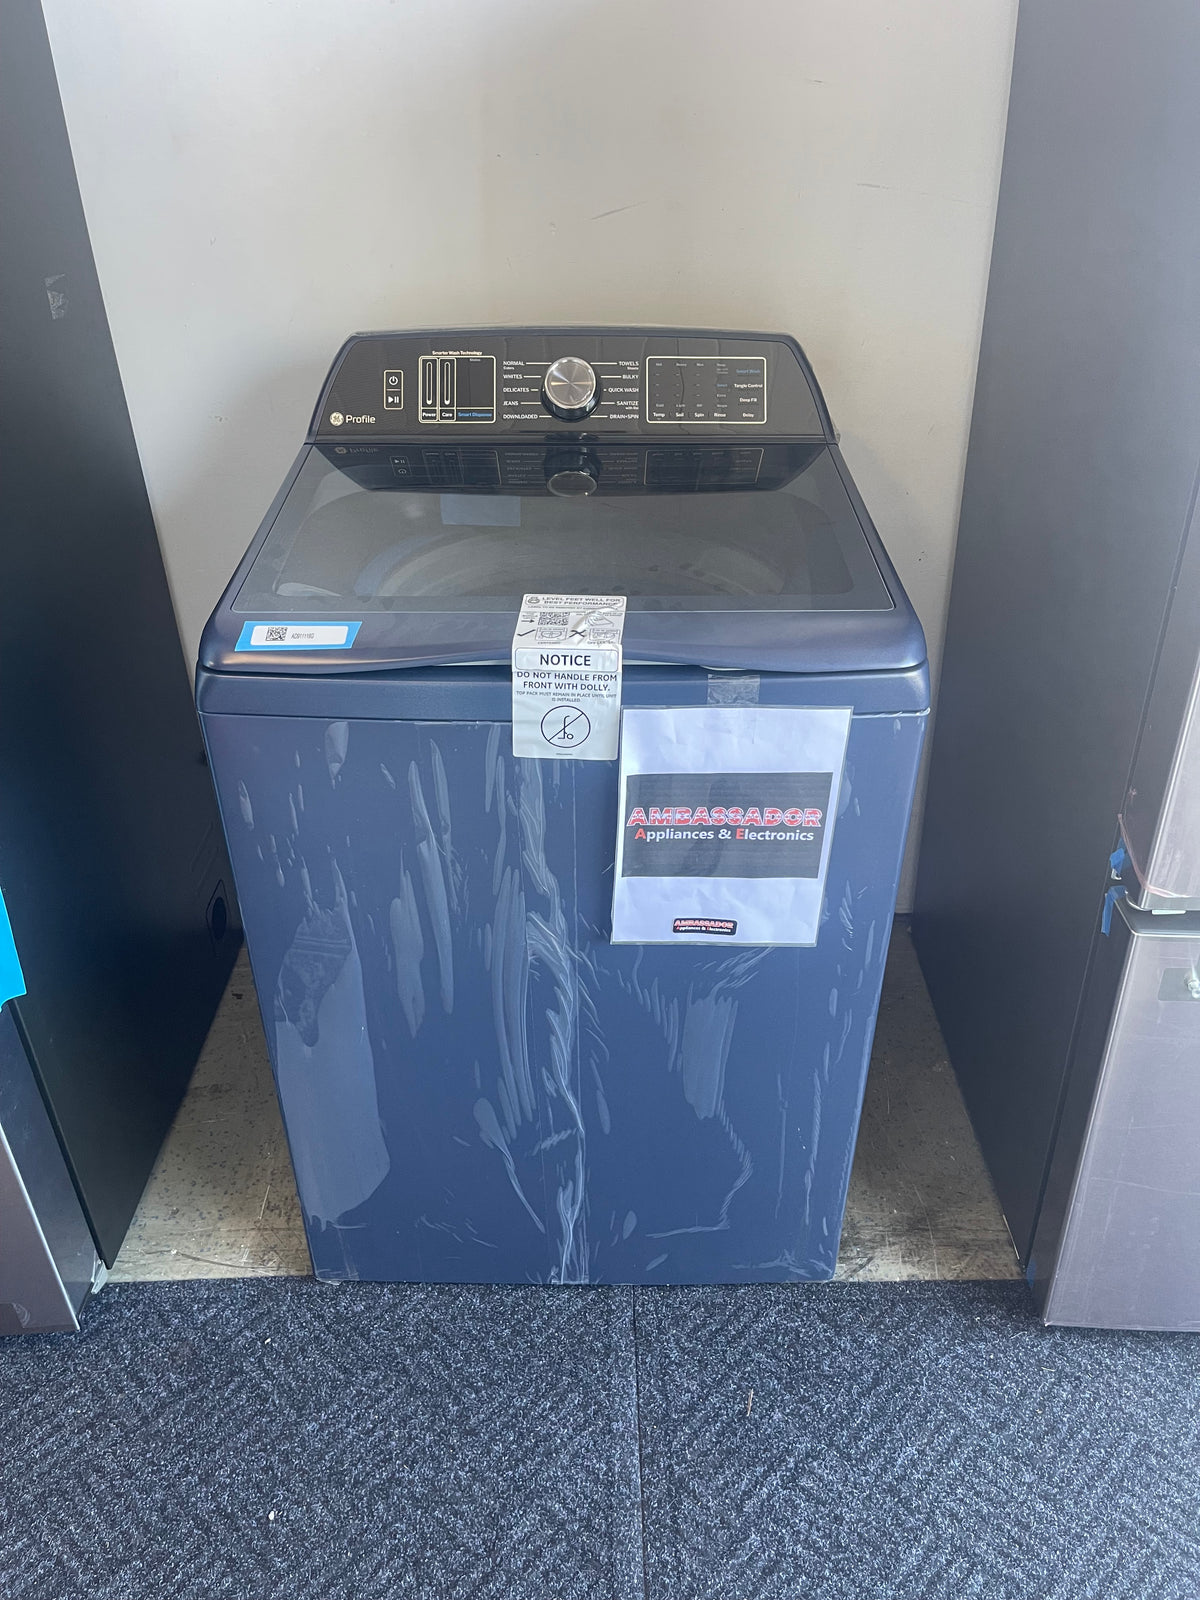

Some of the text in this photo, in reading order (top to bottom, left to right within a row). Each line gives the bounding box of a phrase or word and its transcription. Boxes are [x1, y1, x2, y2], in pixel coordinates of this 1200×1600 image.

[346, 414, 376, 424] Profile
[540, 654, 591, 666] NOTICE
[554, 673, 589, 681] HANDLE
[593, 674, 617, 682] FROM
[524, 681, 552, 689] FRONT
[580, 683, 610, 692] DOLLY.
[626, 807, 823, 828] AMBASSADOR
[634, 828, 814, 842] Appliances & Electronics
[674, 920, 734, 929] AMBASSADOR
